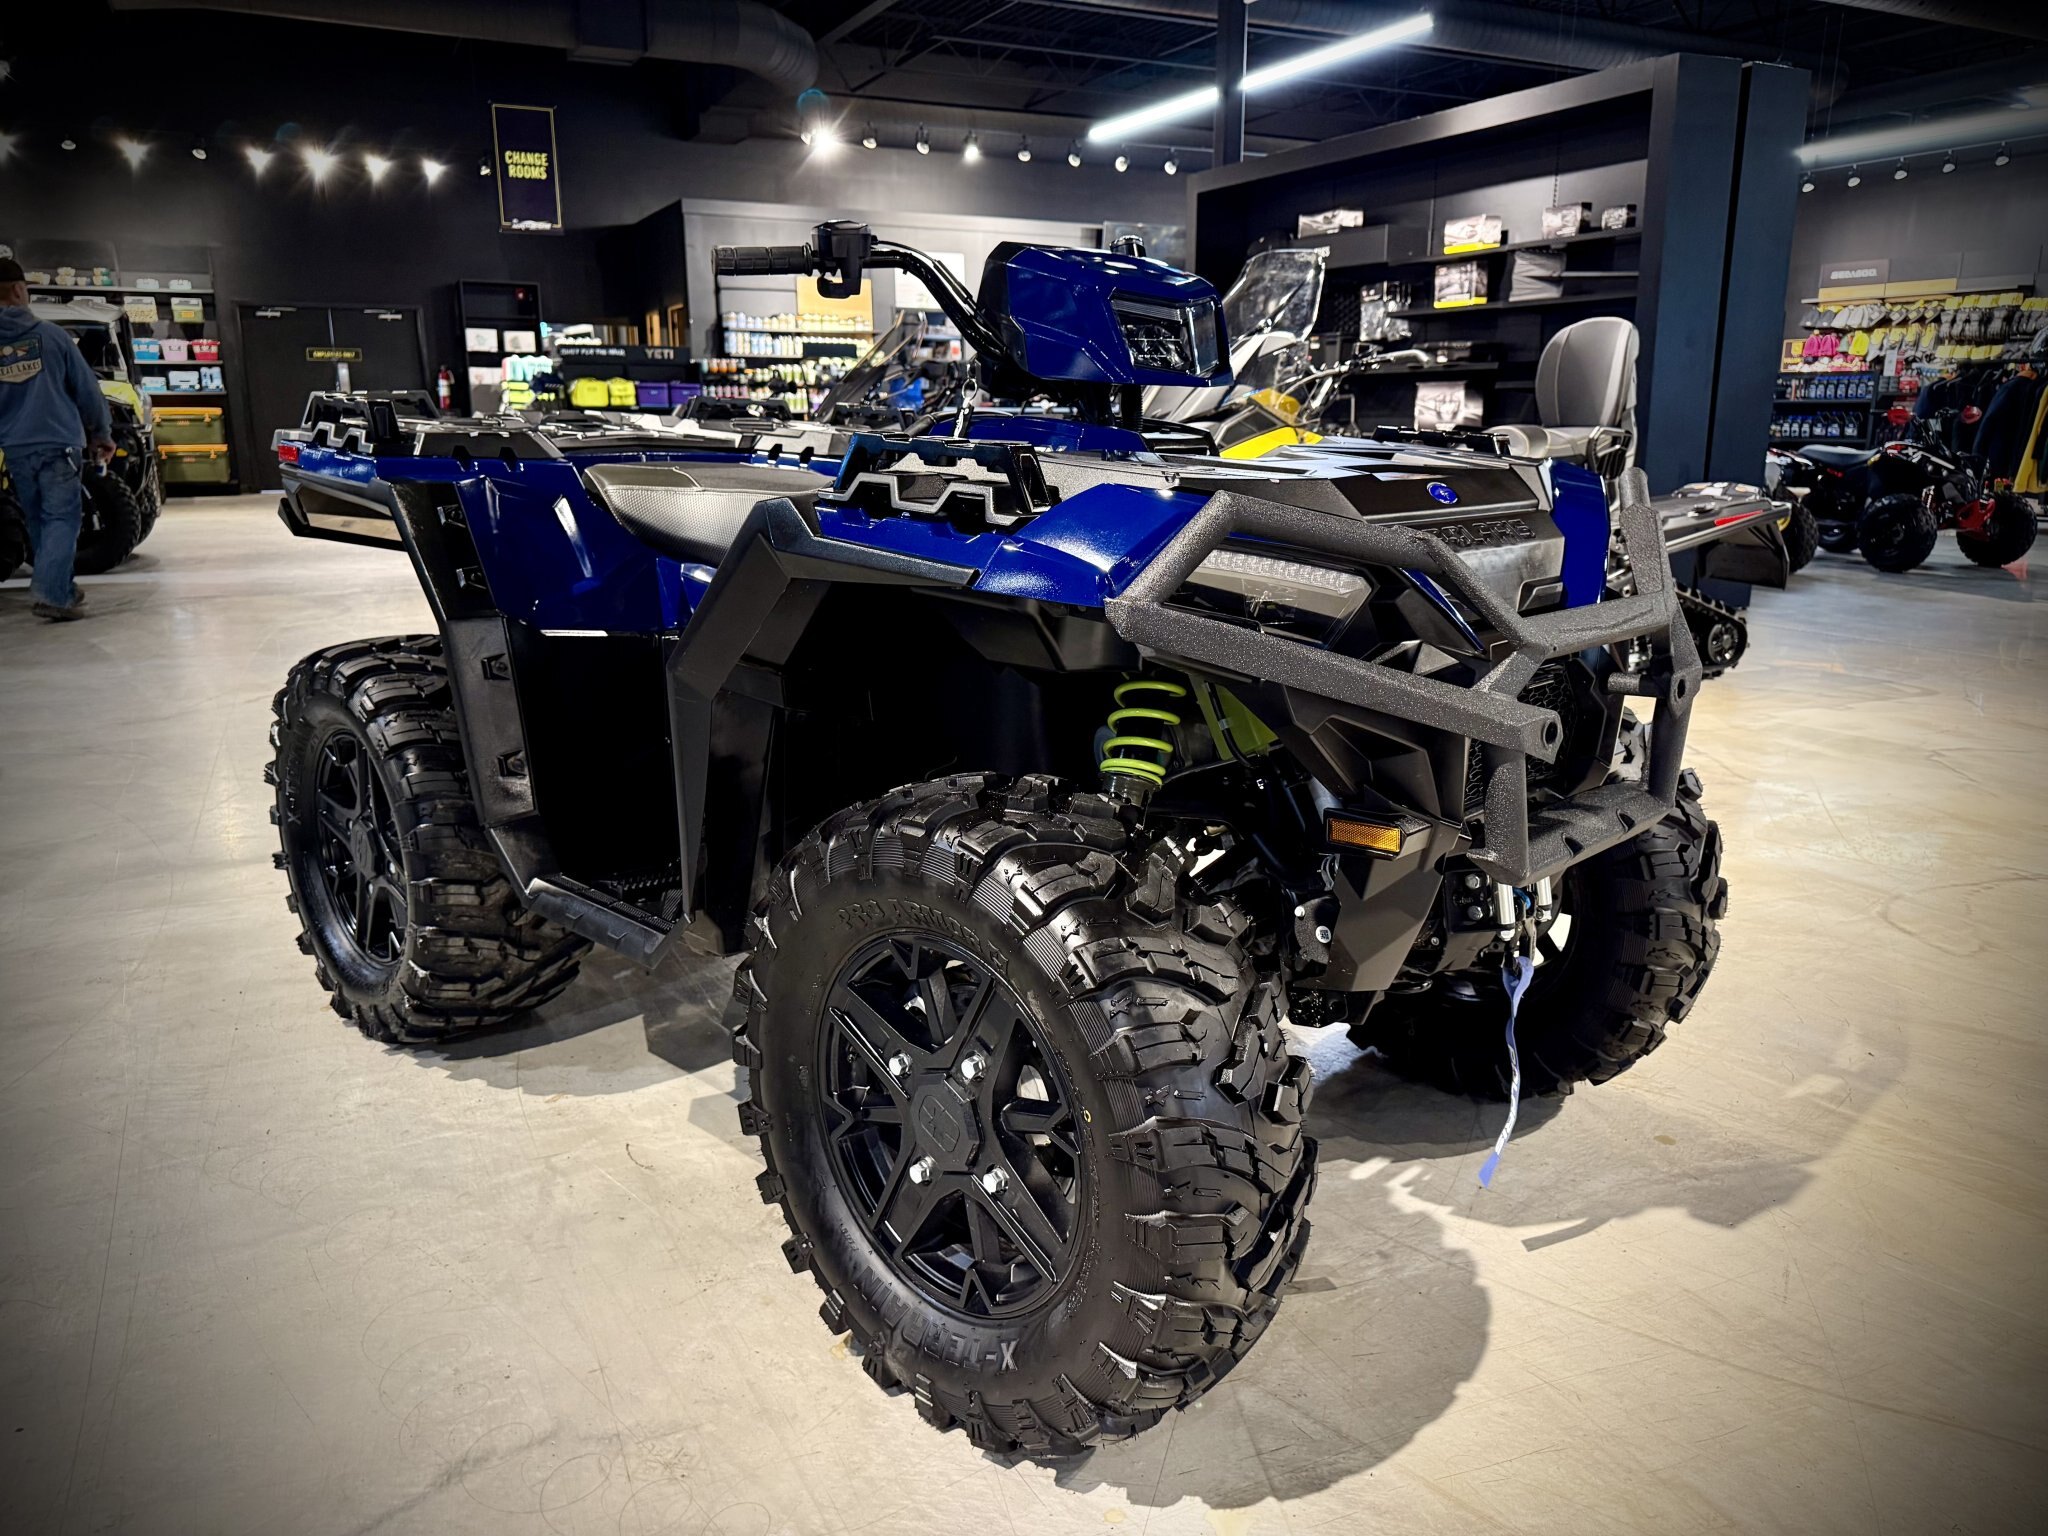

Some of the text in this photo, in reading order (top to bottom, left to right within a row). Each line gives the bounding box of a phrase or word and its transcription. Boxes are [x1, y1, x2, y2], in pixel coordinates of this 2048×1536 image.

[505, 150, 549, 166] CHANGE
[508, 164, 548, 180] ROOMS
[645, 348, 675, 360] YETI
[0, 361, 40, 377] EAT LAKES
[850, 1266, 1020, 1372] X-TERRAIN
